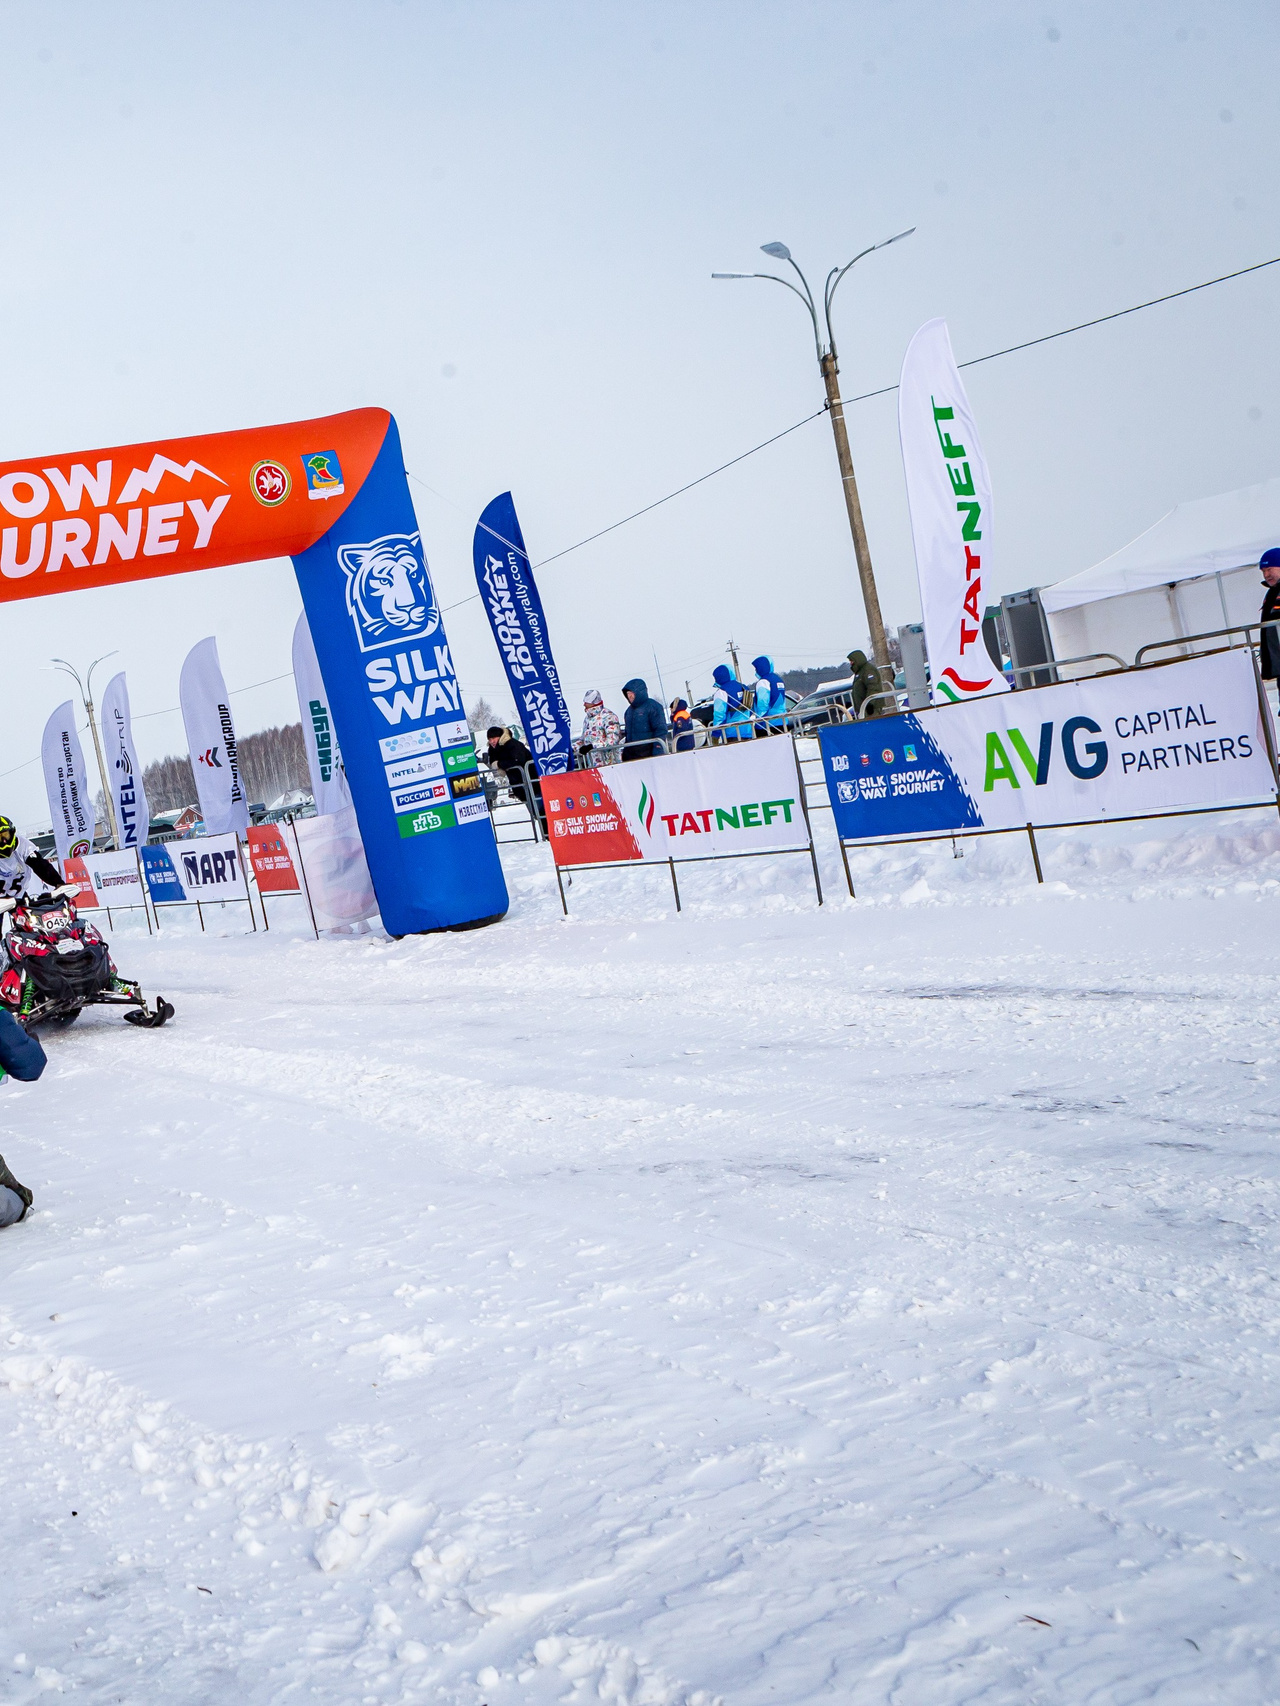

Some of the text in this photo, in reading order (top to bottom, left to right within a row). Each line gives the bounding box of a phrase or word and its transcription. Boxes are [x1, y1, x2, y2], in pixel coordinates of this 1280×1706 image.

[931, 395, 982, 655] TATNEFT
[488, 554, 538, 677] JOURNEY
[488, 597, 525, 680] SNOW
[507, 552, 571, 729] owjourney.silkwayrally.com
[365, 645, 455, 692] SILK
[372, 679, 460, 725] WAY
[522, 690, 549, 754] SILK
[532, 690, 562, 750] WAY
[1114, 703, 1217, 740] CAPITAL
[309, 700, 331, 782] СИБУР
[983, 715, 1109, 793] AVG
[1121, 735, 1254, 774] PARTNERS
[62, 731, 87, 833] Республики Татарстан
[391, 768, 417, 779] INTEL
[859, 769, 926, 789] SILK SNOW
[861, 779, 945, 800] WAY JOURNEY
[58, 767, 74, 837] Правительство
[398, 787, 445, 804] РОССИЯ 24
[414, 812, 440, 831] НТВ
[567, 813, 607, 826] SILK SNOW
[569, 821, 618, 835] WAY JOURNEY
[661, 799, 795, 836] TATNEFT
[182, 850, 237, 886] NART
[46, 918, 65, 930] 045
